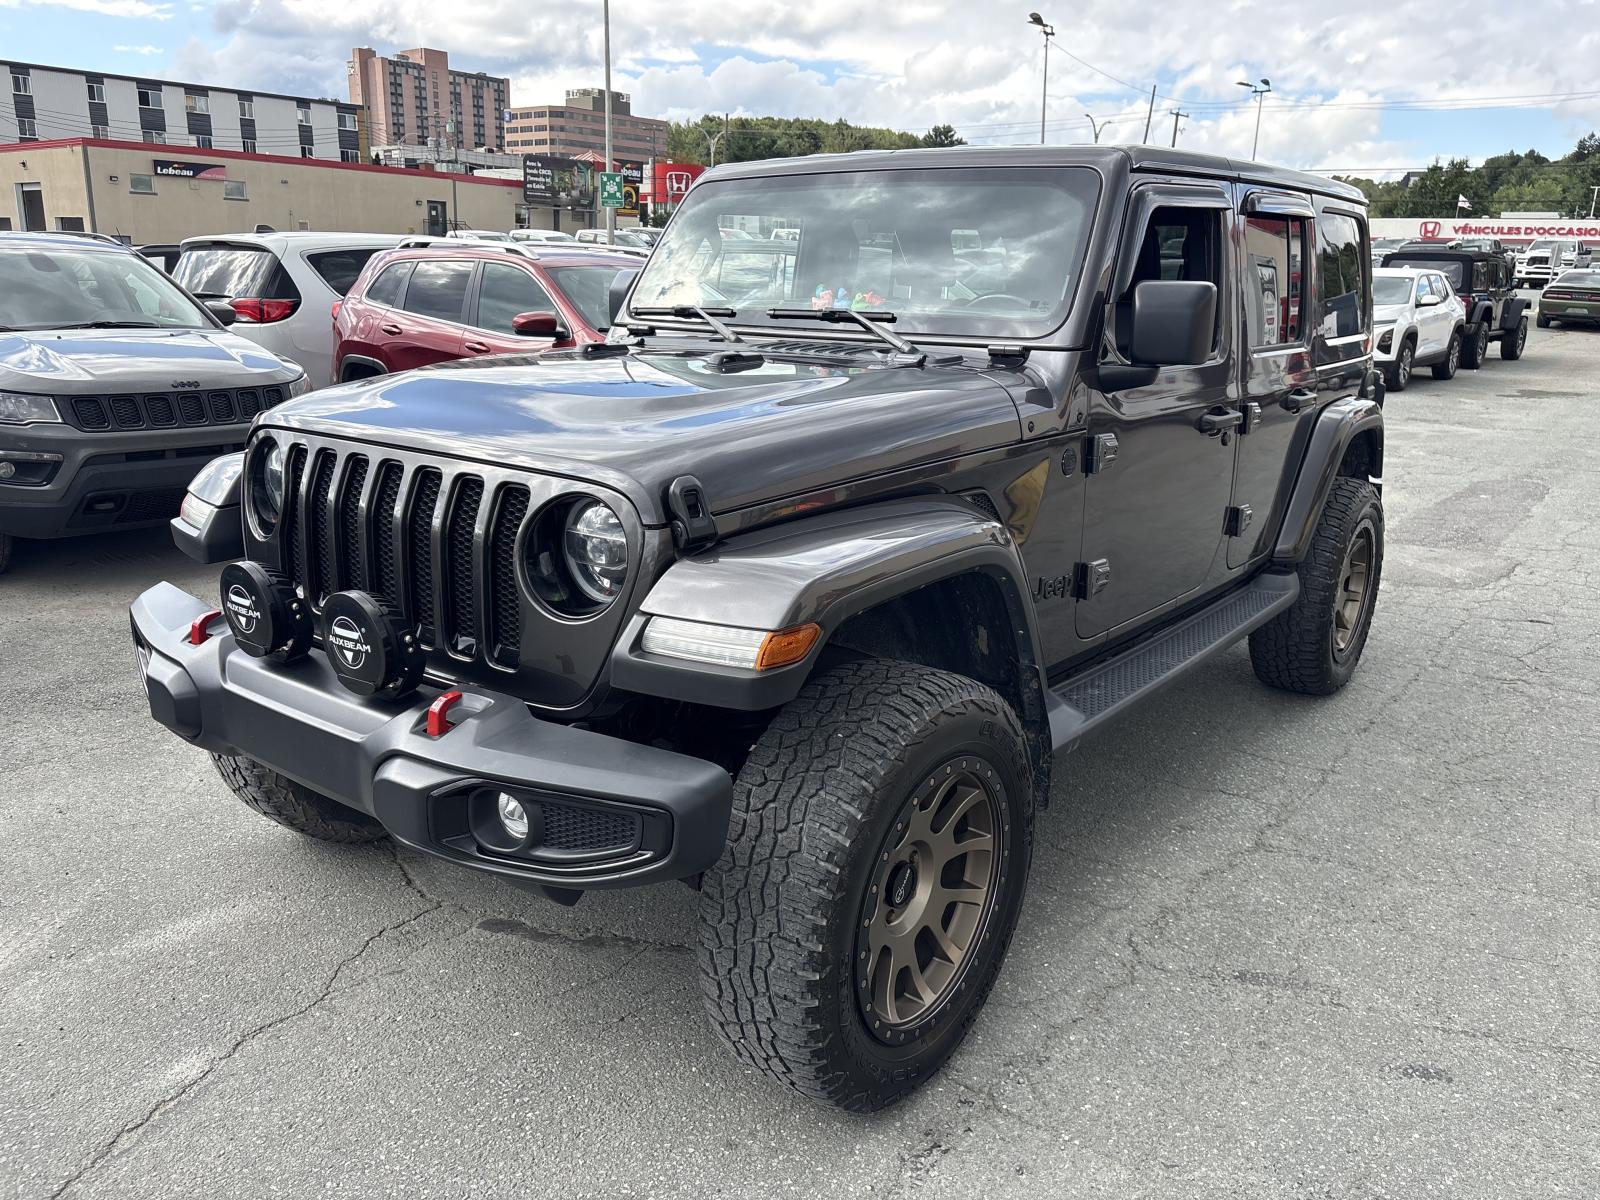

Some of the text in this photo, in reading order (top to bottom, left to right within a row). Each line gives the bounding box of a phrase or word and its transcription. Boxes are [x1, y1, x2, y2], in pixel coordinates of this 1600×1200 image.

[157, 166, 194, 176] Lebeau
[1453, 223, 1522, 235] VÉHICULES
[1524, 226, 1600, 236] D'OCCASIO
[171, 380, 201, 389] Jeep
[1032, 573, 1073, 603] Jeep
[227, 600, 261, 620] AUXBEAM
[329, 634, 372, 654] AUXBEAM
